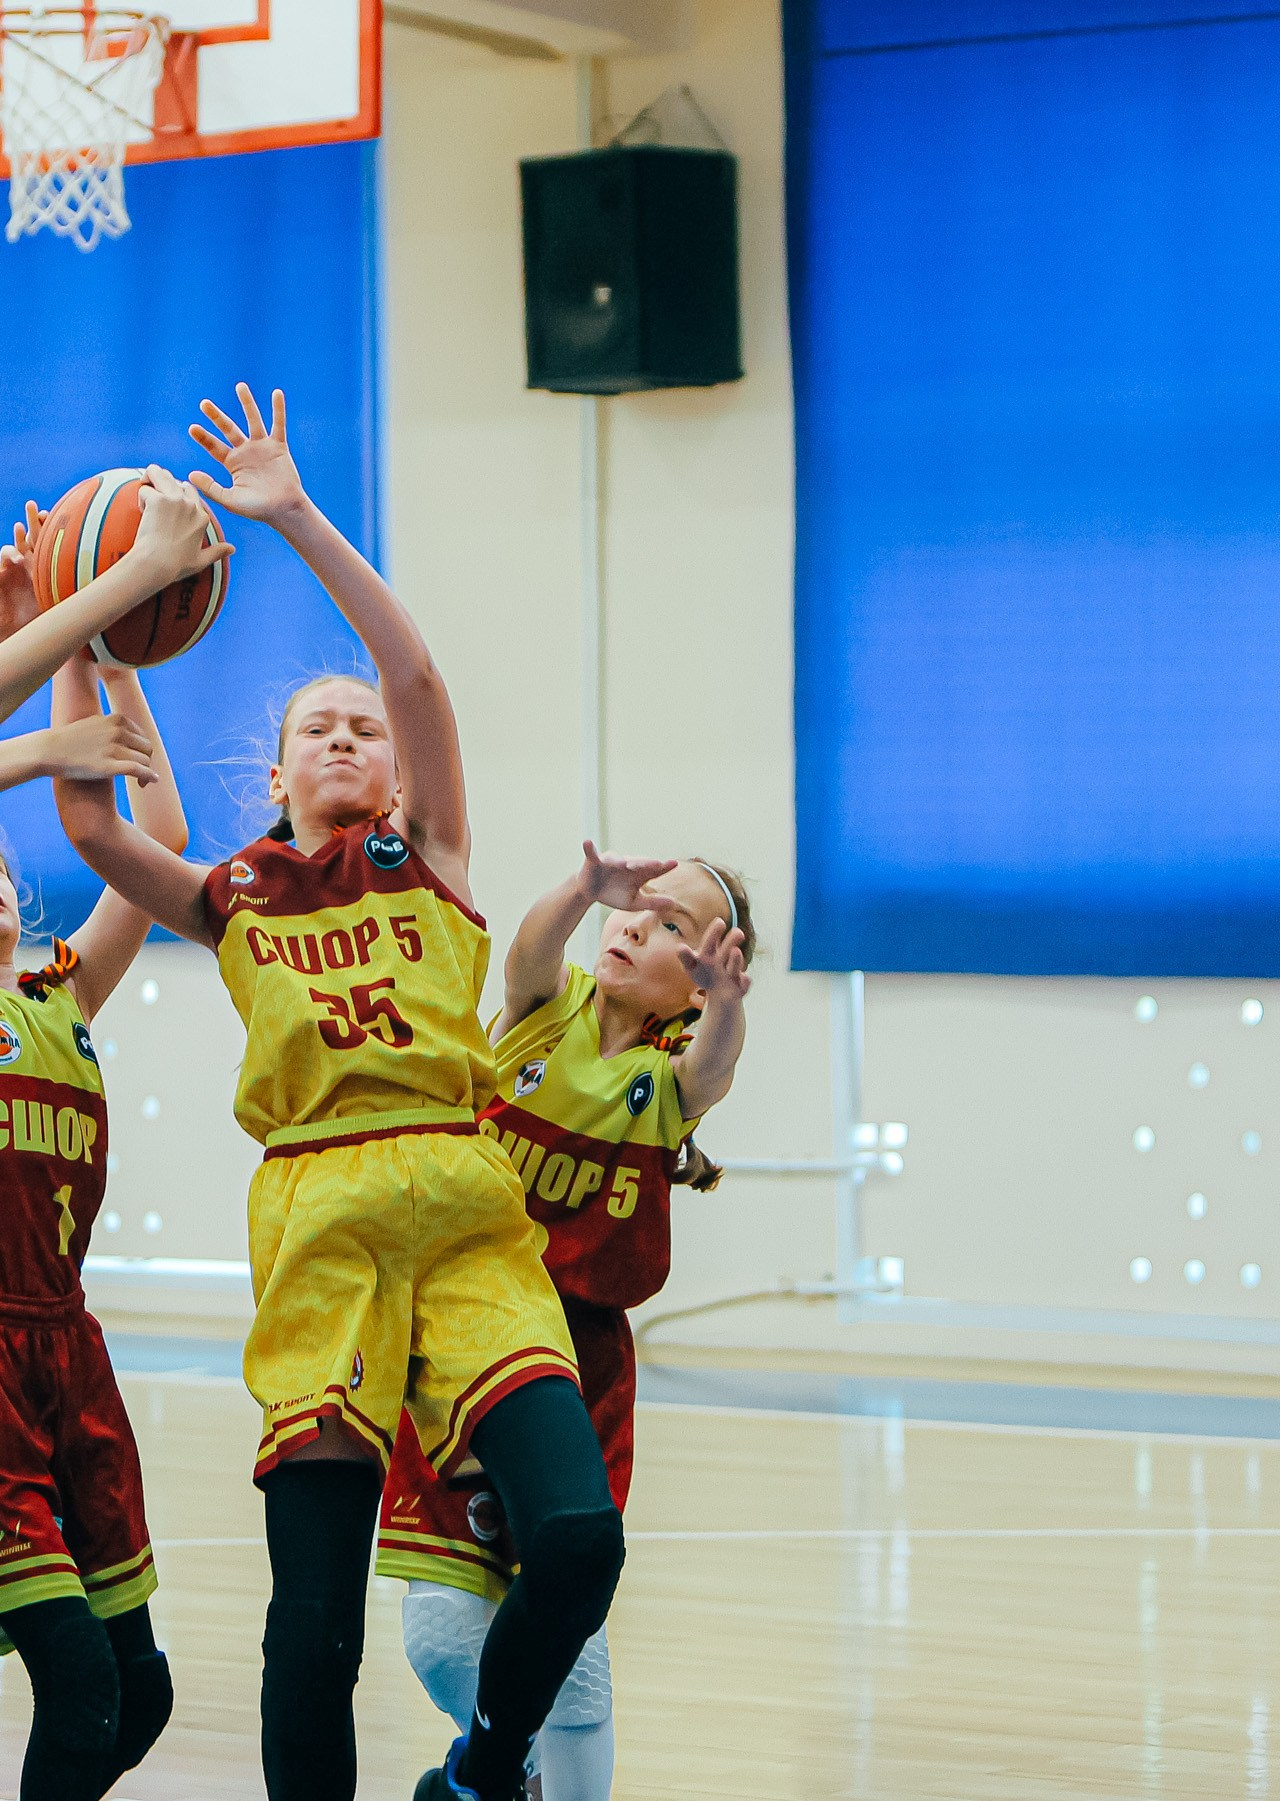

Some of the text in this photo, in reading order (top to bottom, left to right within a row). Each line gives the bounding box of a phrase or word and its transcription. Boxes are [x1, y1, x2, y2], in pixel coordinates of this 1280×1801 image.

[246, 914, 423, 975] СШОР 5
[308, 977, 414, 1050] 35
[53, 1184, 76, 1256] 1
[607, 1165, 641, 1219] 5
